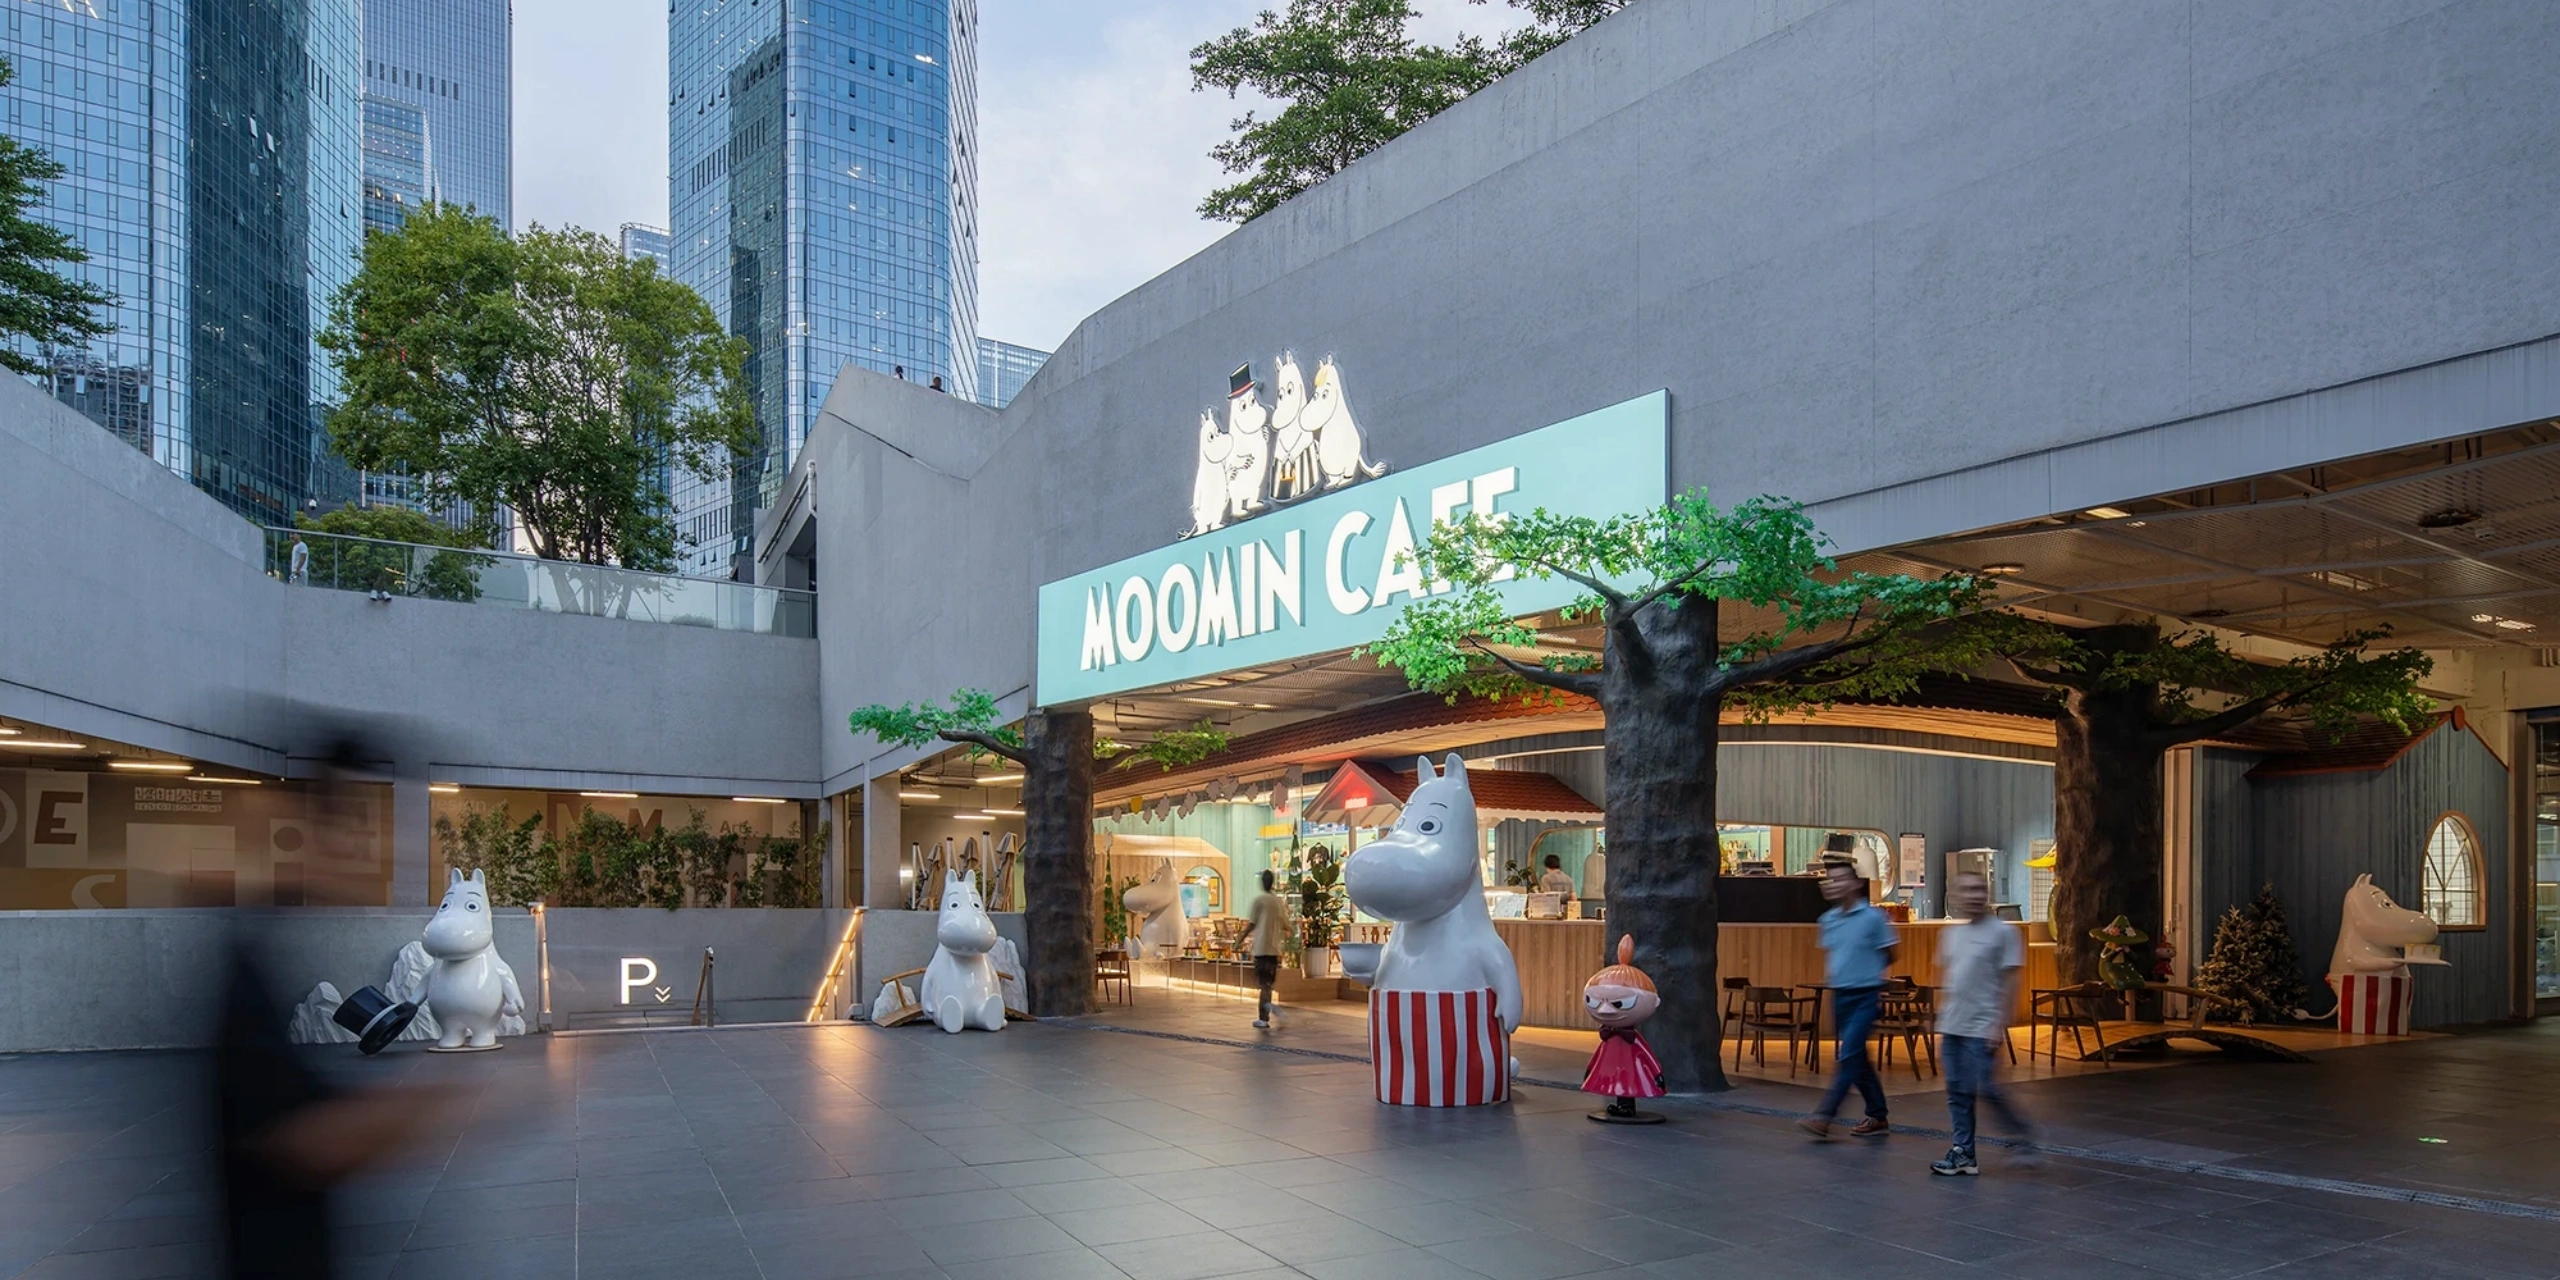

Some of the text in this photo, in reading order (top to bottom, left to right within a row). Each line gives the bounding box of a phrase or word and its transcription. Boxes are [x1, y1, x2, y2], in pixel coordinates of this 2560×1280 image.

[1080, 465, 1519, 672] MOOMIN CAFE
[34, 790, 84, 845] E
[621, 957, 658, 1004] P
